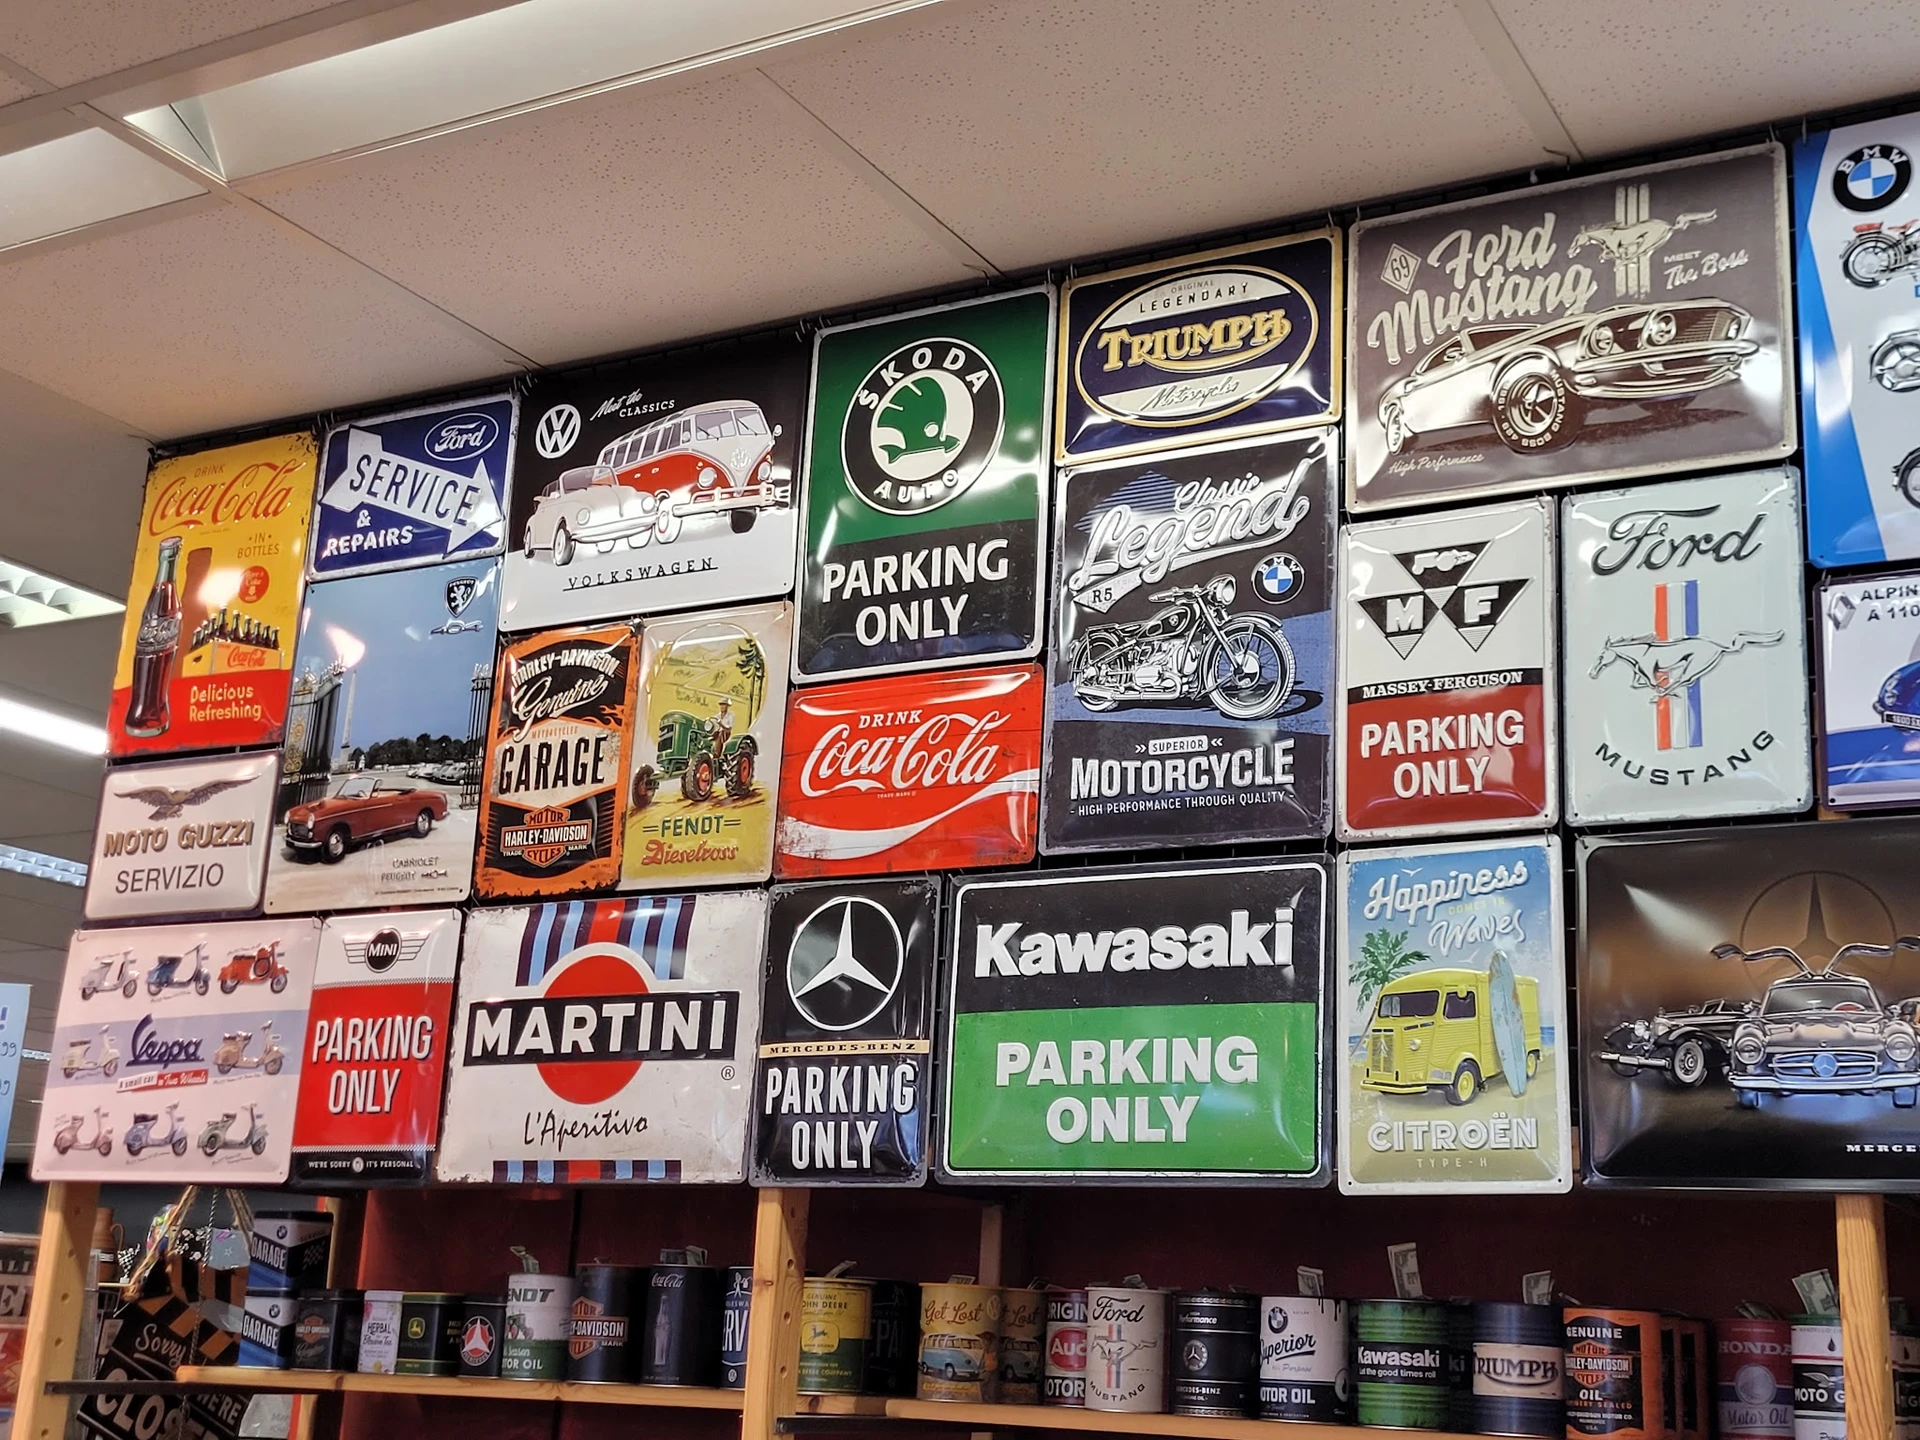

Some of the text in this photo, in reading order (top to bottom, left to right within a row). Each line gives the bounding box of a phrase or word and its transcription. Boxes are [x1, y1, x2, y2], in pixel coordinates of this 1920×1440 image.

[1837, 145, 1909, 175] BMW
[1427, 212, 1557, 289] Ford
[1663, 250, 1702, 264] MEET
[1390, 254, 1410, 282] 69
[1663, 249, 1749, 290] The Boss
[1139, 282, 1249, 314] LEGENDARY
[1170, 279, 1214, 293] ORIGINAL
[1367, 264, 1598, 365] Mustang
[1097, 308, 1292, 374] TRIUMPH
[590, 389, 643, 421] Meet the
[619, 400, 675, 418] CLASSICS
[434, 420, 487, 452] Ford
[194, 464, 226, 478] DRINK
[1388, 453, 1484, 477] High Performance
[150, 458, 307, 536] Coca-Cola
[349, 454, 481, 526] SERVICE
[873, 469, 958, 503] AUTO
[1174, 472, 1264, 514] Classic
[356, 510, 372, 528] &
[1068, 458, 1312, 593] Legend
[237, 543, 280, 559] BOTTLES
[324, 525, 414, 556] REPAIRS
[1591, 504, 1769, 576] Ford
[568, 557, 714, 589] VOLKSWAGEN
[822, 539, 1009, 603] PARKING
[1261, 556, 1300, 573] BMW
[856, 594, 969, 647] ONLY
[1386, 585, 1499, 634] M F
[1867, 609, 1880, 621] A
[511, 649, 621, 689] HARLEY-DAVIDSON
[190, 683, 254, 704] Delicious
[1362, 671, 1524, 699] MASSEY-FERGUSON
[189, 702, 262, 722] Refreshing
[511, 674, 609, 742] Genuine
[858, 710, 923, 729] DRINK
[531, 725, 579, 740] MOTORCYCLES
[1152, 740, 1204, 752] SUPERIOR
[1361, 709, 1524, 759] PARKING
[500, 734, 608, 795] GARAGE
[801, 711, 1012, 798] Coca-Cola
[1070, 738, 1295, 800] MOTORCYCLE
[1595, 729, 1775, 786] MUSTANG
[1393, 755, 1490, 800] ONLY
[529, 811, 564, 824] MOTOR
[1078, 790, 1285, 816] HIGH PERFORMANCE THROUGH QUALITY
[103, 819, 255, 858] MOTO GUZZI
[504, 825, 588, 848] HARLEY-DAVIDSON
[661, 814, 724, 837] FENDT
[526, 847, 563, 865] CYCLES
[568, 844, 588, 852] MARK
[641, 839, 739, 865] Dieselross
[115, 863, 224, 894] SERVIZIO
[1363, 859, 1529, 927] Happiness
[1448, 898, 1488, 916] COMES
[975, 906, 1294, 978] Kawasaki
[1428, 909, 1526, 957] Waves
[369, 943, 398, 957] MINI
[125, 1013, 205, 1070] Vespa
[312, 1015, 434, 1064] PARKING
[471, 1000, 727, 1057] MARTINI
[769, 1042, 917, 1054] MERCEDES-BENZ
[995, 1035, 1259, 1087] PARKING
[143, 1075, 154, 1084] car
[328, 1069, 401, 1115] ONLY
[765, 1063, 916, 1115] PARKING
[524, 1109, 649, 1152] L'Aperitivo
[1046, 1095, 1200, 1144] ONLY
[1367, 1111, 1538, 1153] CITROËN
[791, 1120, 879, 1170] ONLY
[309, 1161, 328, 1169] WE'RE
[366, 1160, 378, 1168] IT'S
[380, 1160, 414, 1168] PERSONAL
[1416, 1157, 1488, 1169] TYPE-H
[251, 1236, 286, 1271] GARAGE
[822, 1301, 848, 1309] DEERE
[924, 1301, 984, 1325] Get Lost
[1008, 1306, 1041, 1328] Lost
[1092, 1296, 1144, 1323] Ford
[242, 1315, 279, 1350] GARAGE
[367, 1322, 392, 1335] HERBAL
[1566, 1326, 1623, 1339] GENUINE
[135, 1323, 187, 1367] Sorry
[1358, 1346, 1440, 1367] Kawasaki
[1575, 1343, 1605, 1355] MOTOR
[522, 1359, 543, 1370] OIL
[1377, 1369, 1399, 1378] good
[1400, 1369, 1423, 1378] times
[1425, 1370, 1437, 1378] roll
[1577, 1373, 1606, 1385] CYCLES
[1089, 1381, 1145, 1402] MUSTANG
[1291, 1388, 1316, 1404] OIL
[1579, 1389, 1604, 1401] OIL
[1795, 1388, 1828, 1402] MOTO
[1728, 1407, 1789, 1425] Motor Oil
